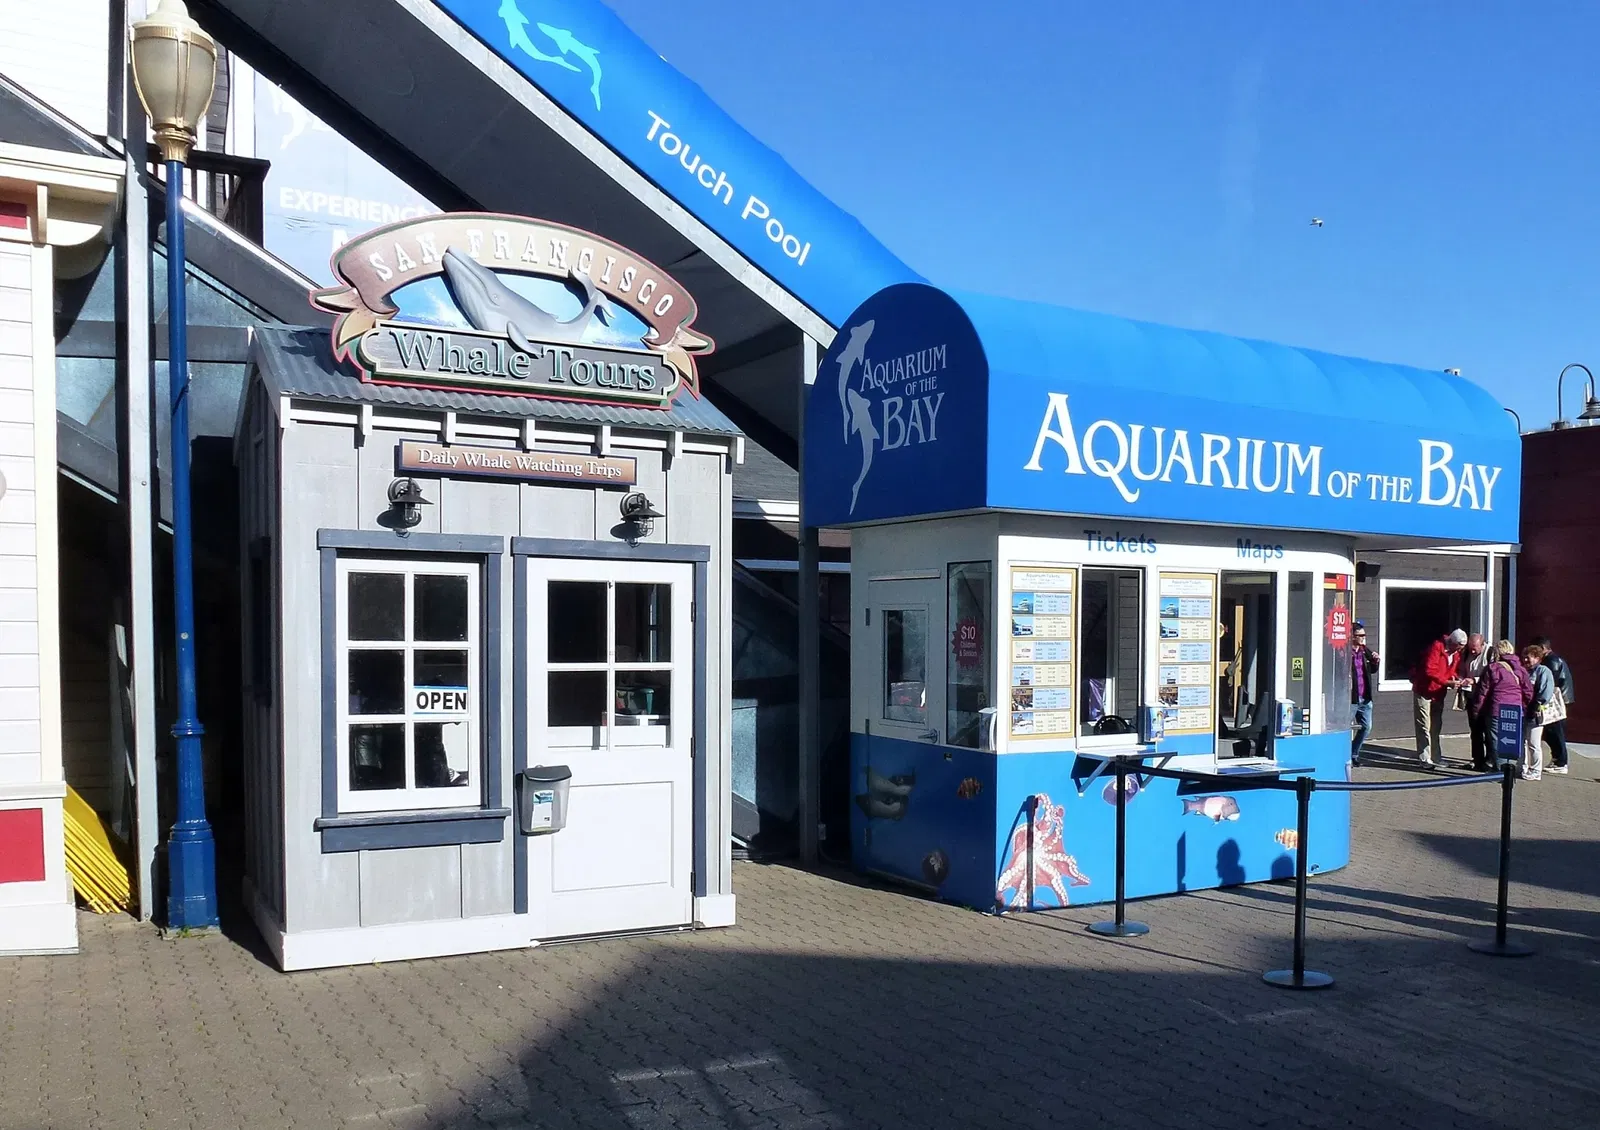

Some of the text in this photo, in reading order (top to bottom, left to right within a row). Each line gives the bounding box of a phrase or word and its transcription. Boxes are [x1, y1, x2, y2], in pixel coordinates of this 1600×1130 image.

[646, 109, 811, 267] Touch Pool
[369, 228, 674, 317] SAN FRANCISCO
[389, 329, 658, 391] Whale Tours
[860, 344, 947, 394] AQUARIUM
[905, 376, 938, 396] OF THE
[881, 392, 945, 451] BAY
[418, 449, 622, 477] Daily Whale Watching Trips
[1023, 392, 1502, 511] AQUARIUM OF THE BAY
[1083, 530, 1157, 554] Tickets
[1237, 538, 1284, 563] Maps
[1333, 611, 1345, 626] $10
[960, 625, 976, 640] $10
[416, 691, 467, 710] OPEN
[1500, 709, 1519, 720] ENTER
[1501, 722, 1516, 732] HERE
